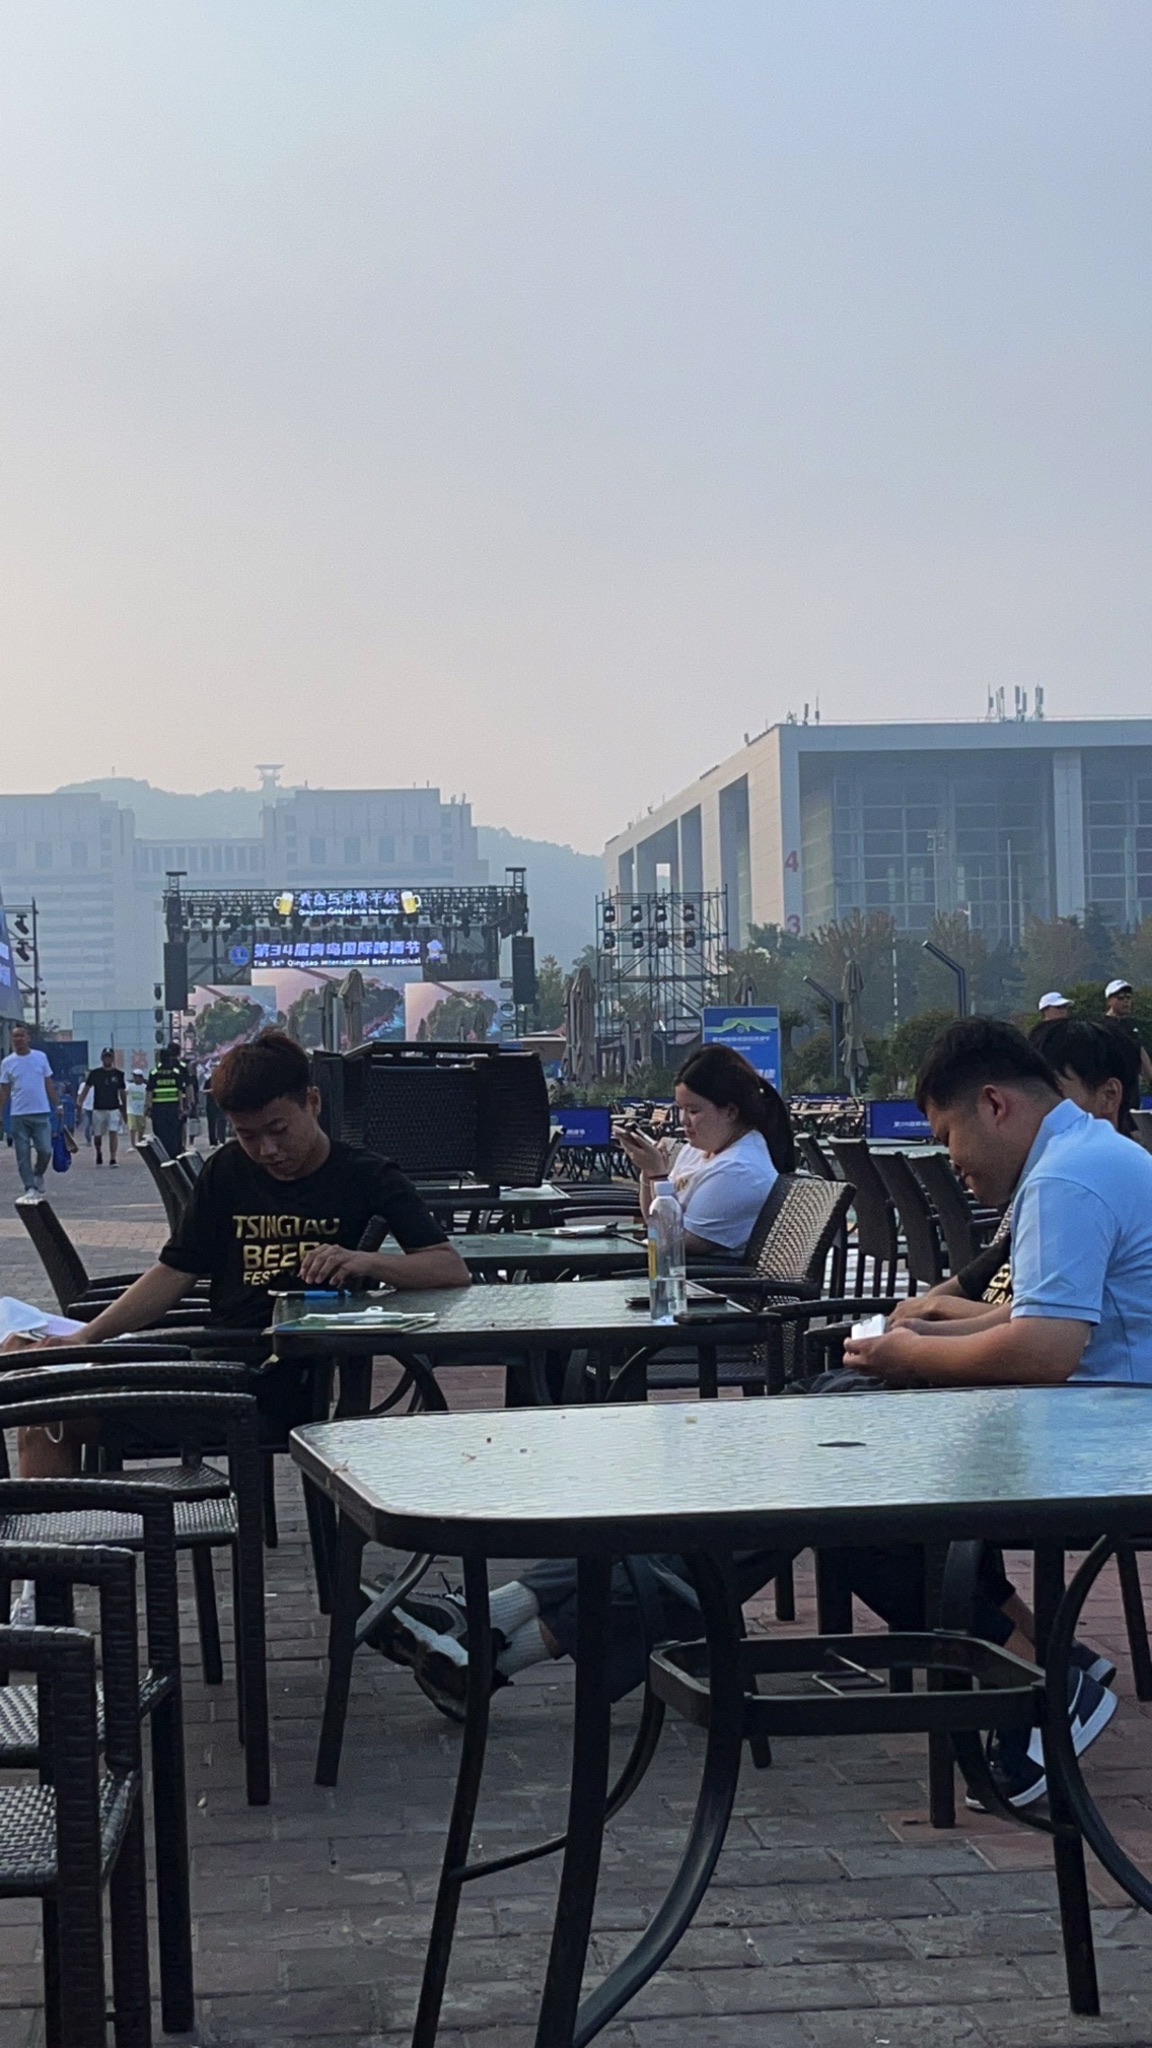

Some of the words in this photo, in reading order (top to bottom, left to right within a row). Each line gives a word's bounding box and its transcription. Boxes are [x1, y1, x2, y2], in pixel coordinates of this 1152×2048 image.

[784, 849, 800, 873] 4
[786, 914, 801, 935] 3
[254, 942, 420, 957] 第34届青岛国际啤酒节
[232, 1215, 340, 1239] TSINGTAO
